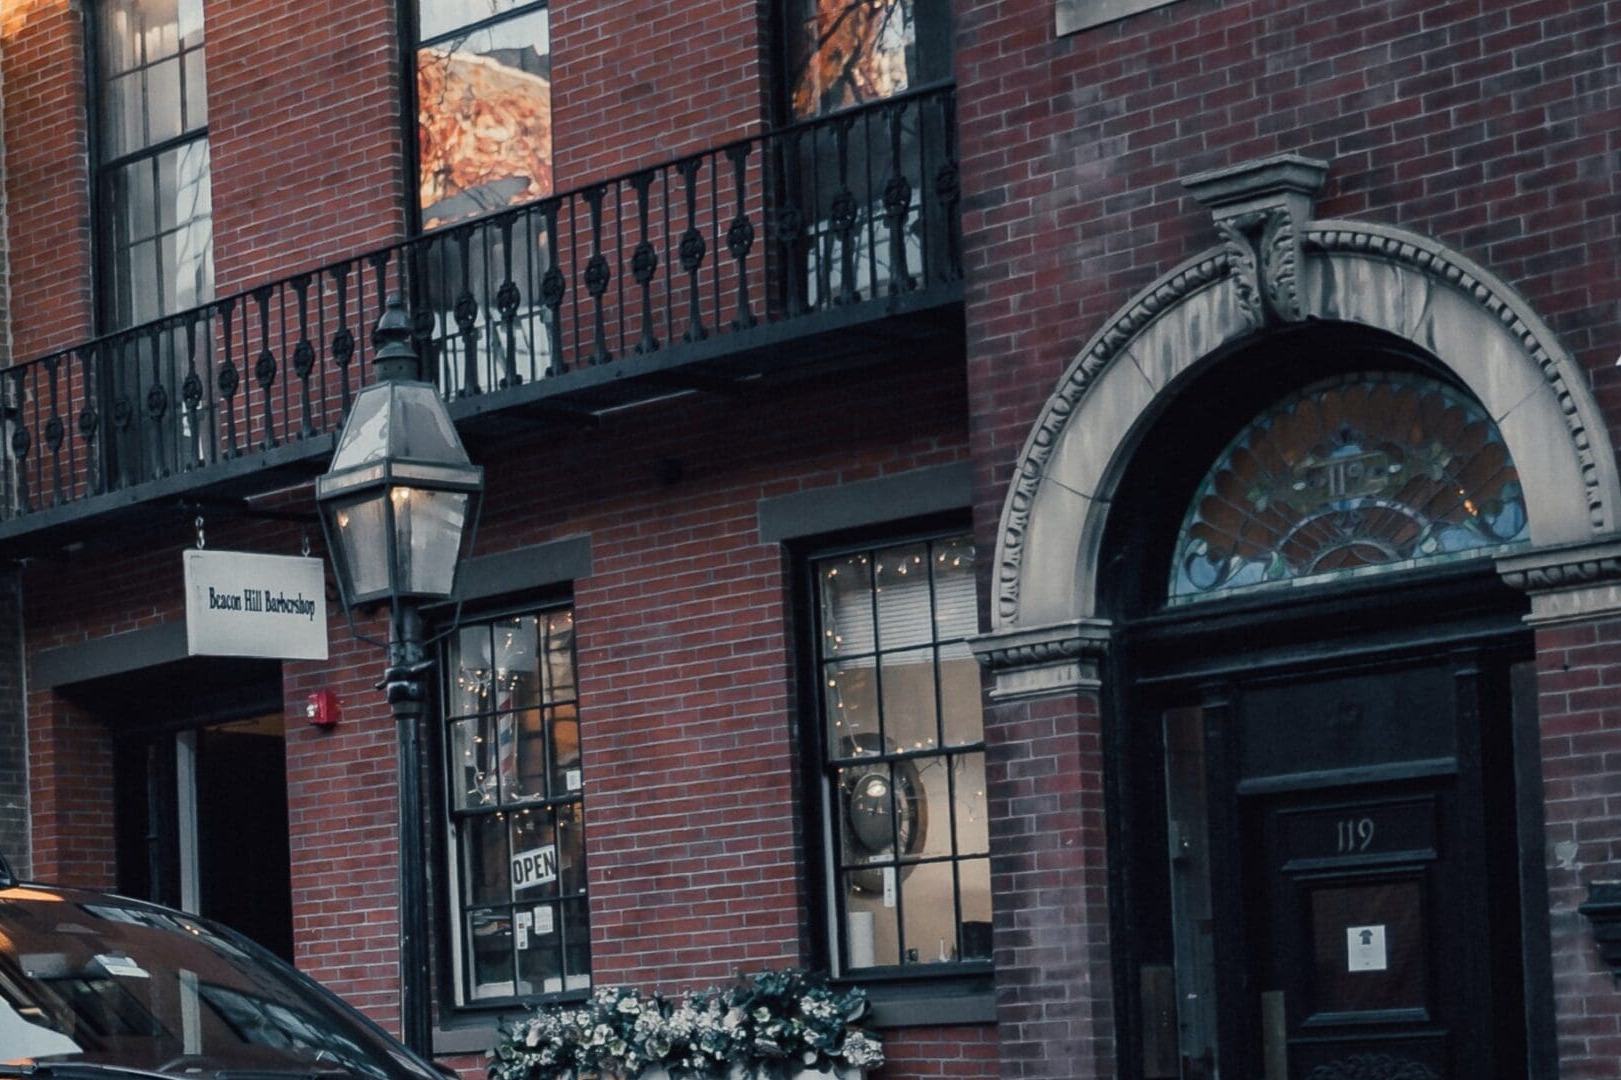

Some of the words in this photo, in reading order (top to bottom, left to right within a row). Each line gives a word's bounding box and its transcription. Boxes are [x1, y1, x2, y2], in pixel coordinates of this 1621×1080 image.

[209, 587, 241, 610] Beacon
[244, 589, 262, 612] Hill
[265, 590, 315, 621] Barbershop
[1338, 818, 1374, 851] 119
[513, 850, 556, 885] OPEN
